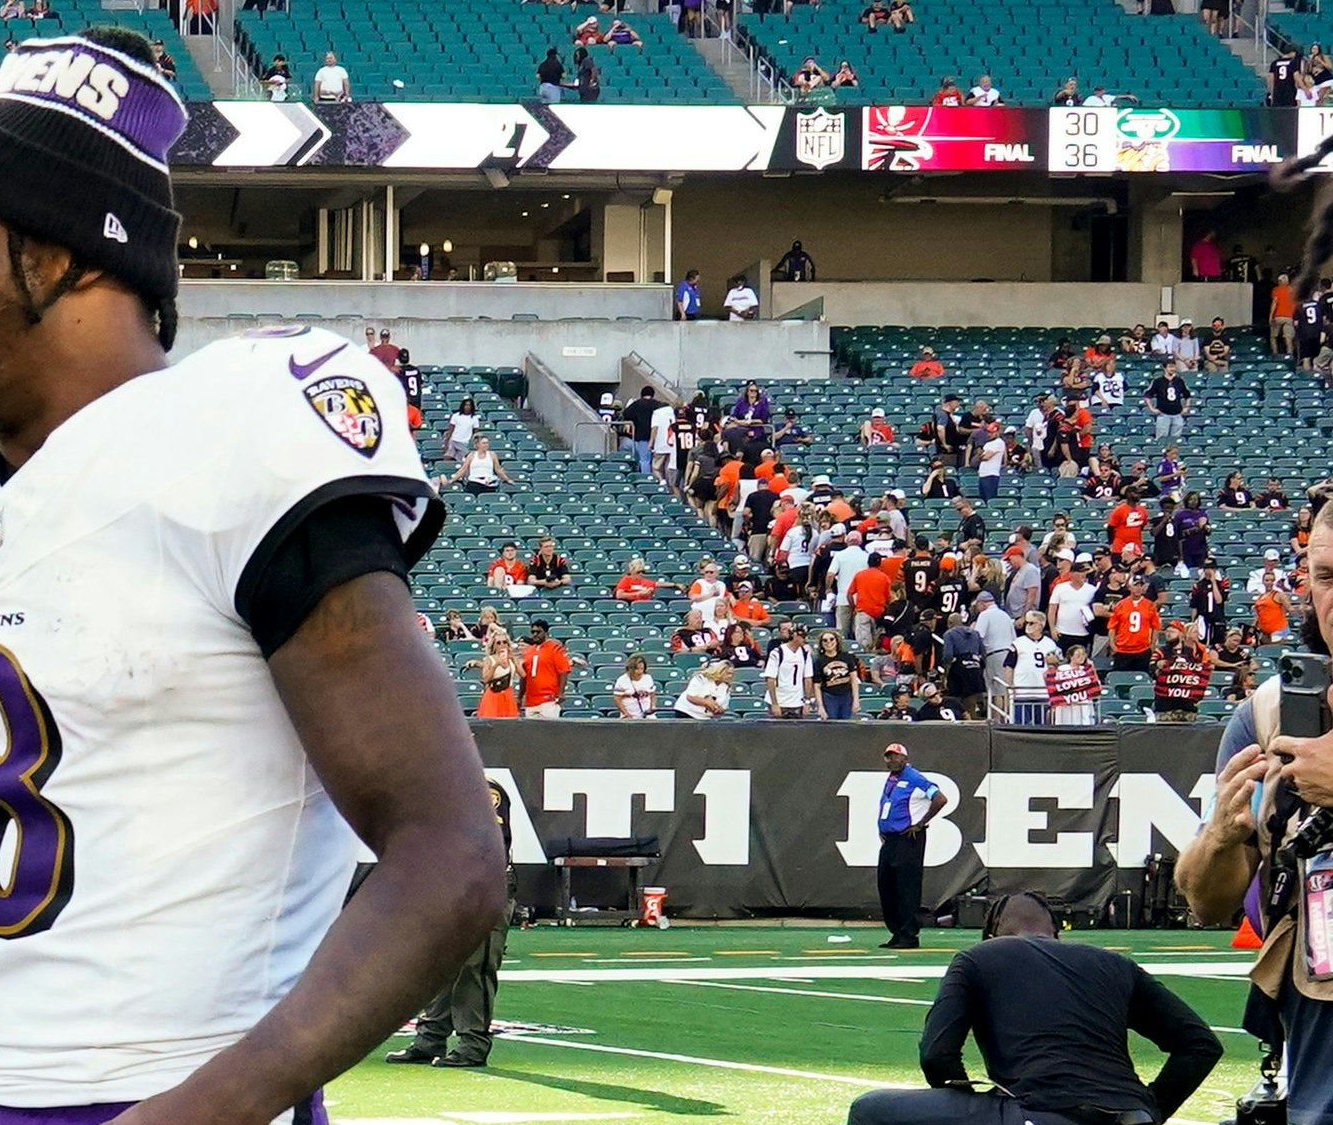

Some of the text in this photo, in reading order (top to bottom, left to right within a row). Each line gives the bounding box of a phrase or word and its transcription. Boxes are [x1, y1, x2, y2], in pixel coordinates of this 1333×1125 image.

[1278, 66, 1287, 78] 9
[1064, 112, 1099, 135] 30
[804, 136, 836, 157] NFL
[984, 143, 1035, 163] FINAL
[1064, 143, 1099, 167] 36
[1232, 144, 1283, 163] FINAL
[1306, 307, 1317, 324] 9
[305, 380, 364, 397] RAVENS
[408, 377, 417, 396] 9
[1166, 388, 1176, 401] 8
[696, 414, 704, 428] 9
[678, 432, 693, 450] 18
[941, 484, 948, 497] 1
[1165, 522, 1174, 537] 8
[915, 571, 927, 593] 9
[941, 592, 960, 613] 91
[1207, 592, 1213, 613] 1
[1129, 612, 1141, 632] 9
[734, 647, 749, 661] 9
[1034, 652, 1045, 668] 9
[531, 656, 539, 677] 1
[792, 664, 799, 685] 1
[1053, 668, 1087, 681] JESUS
[1170, 662, 1203, 672] JESUS
[1055, 676, 1092, 692] LOVES
[1166, 675, 1201, 686] LOVES
[1064, 691, 1088, 707] YOU
[1167, 688, 1191, 699] YOU
